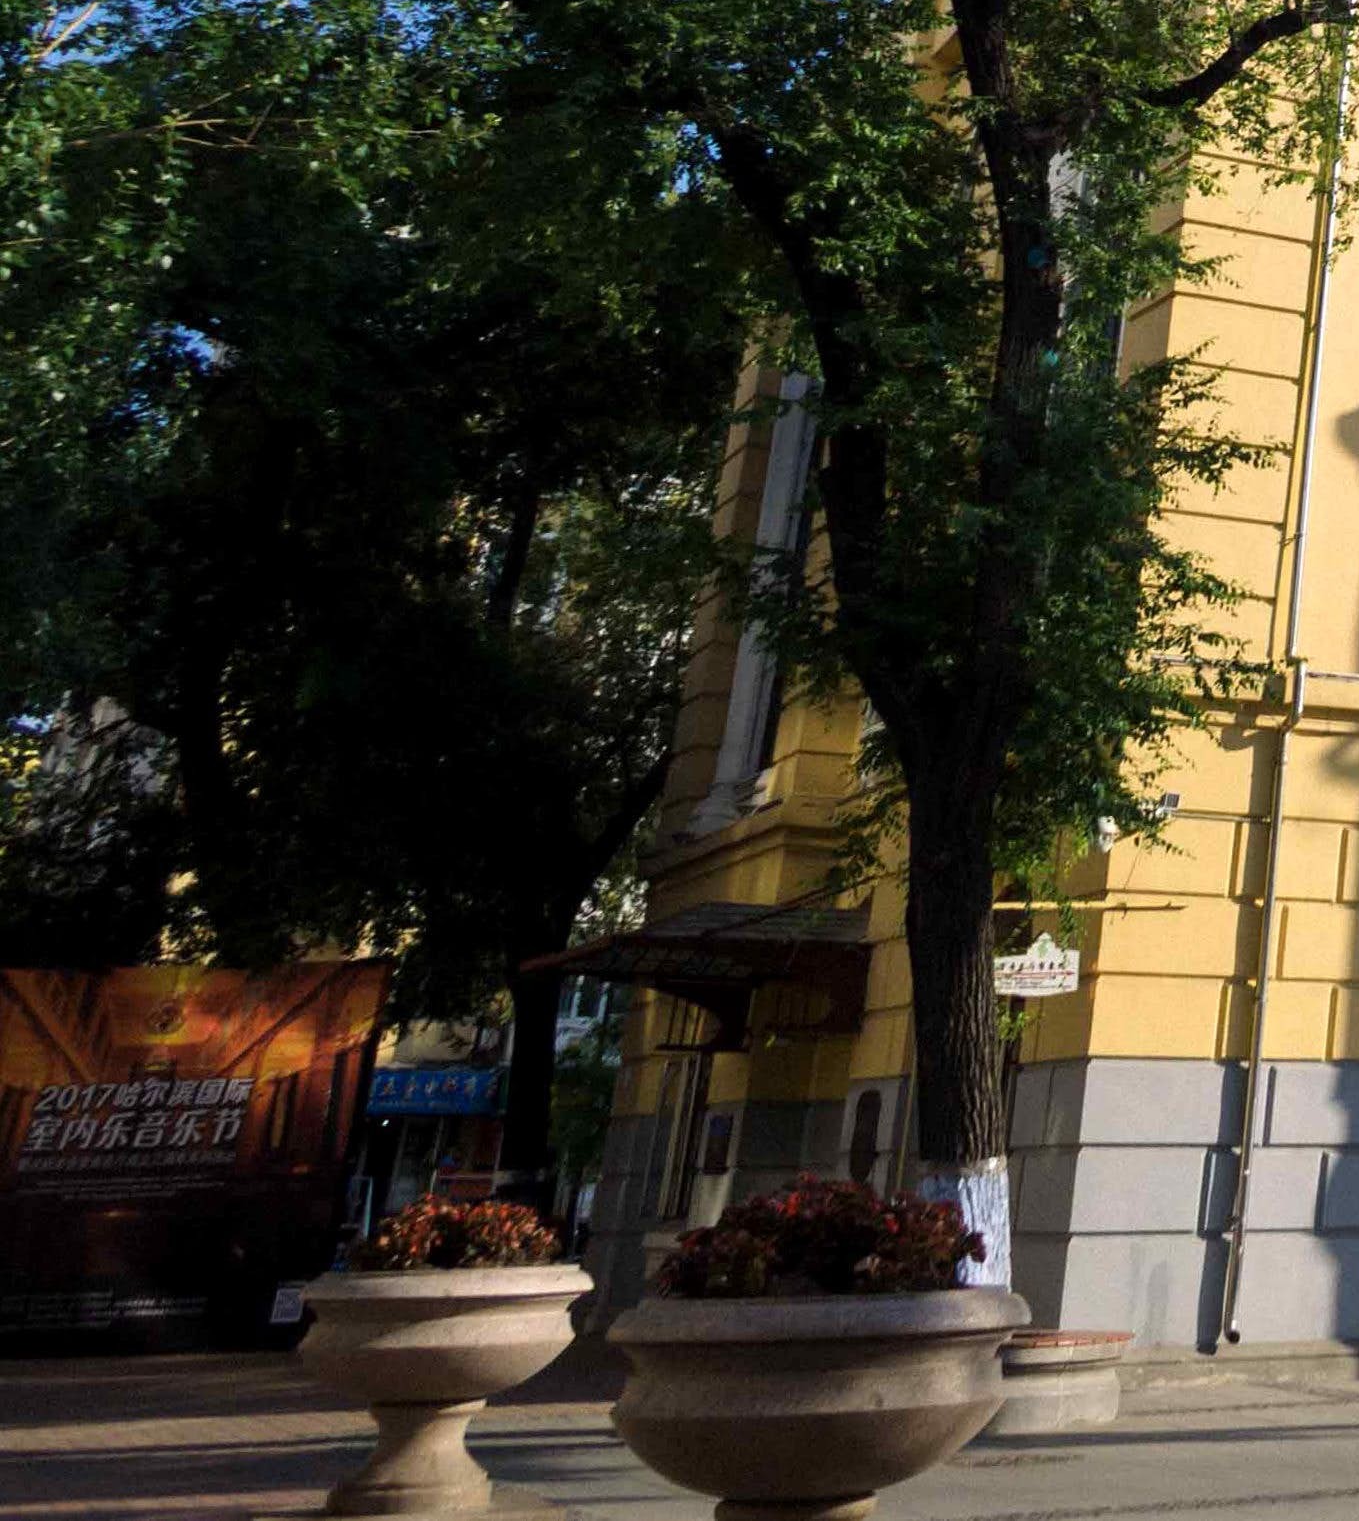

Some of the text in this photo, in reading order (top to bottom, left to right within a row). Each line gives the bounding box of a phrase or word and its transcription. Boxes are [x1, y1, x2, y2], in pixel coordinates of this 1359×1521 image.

[34, 1078, 254, 1112] 2017哈尔滨国际
[25, 1108, 244, 1151] 室内乐音乐节
